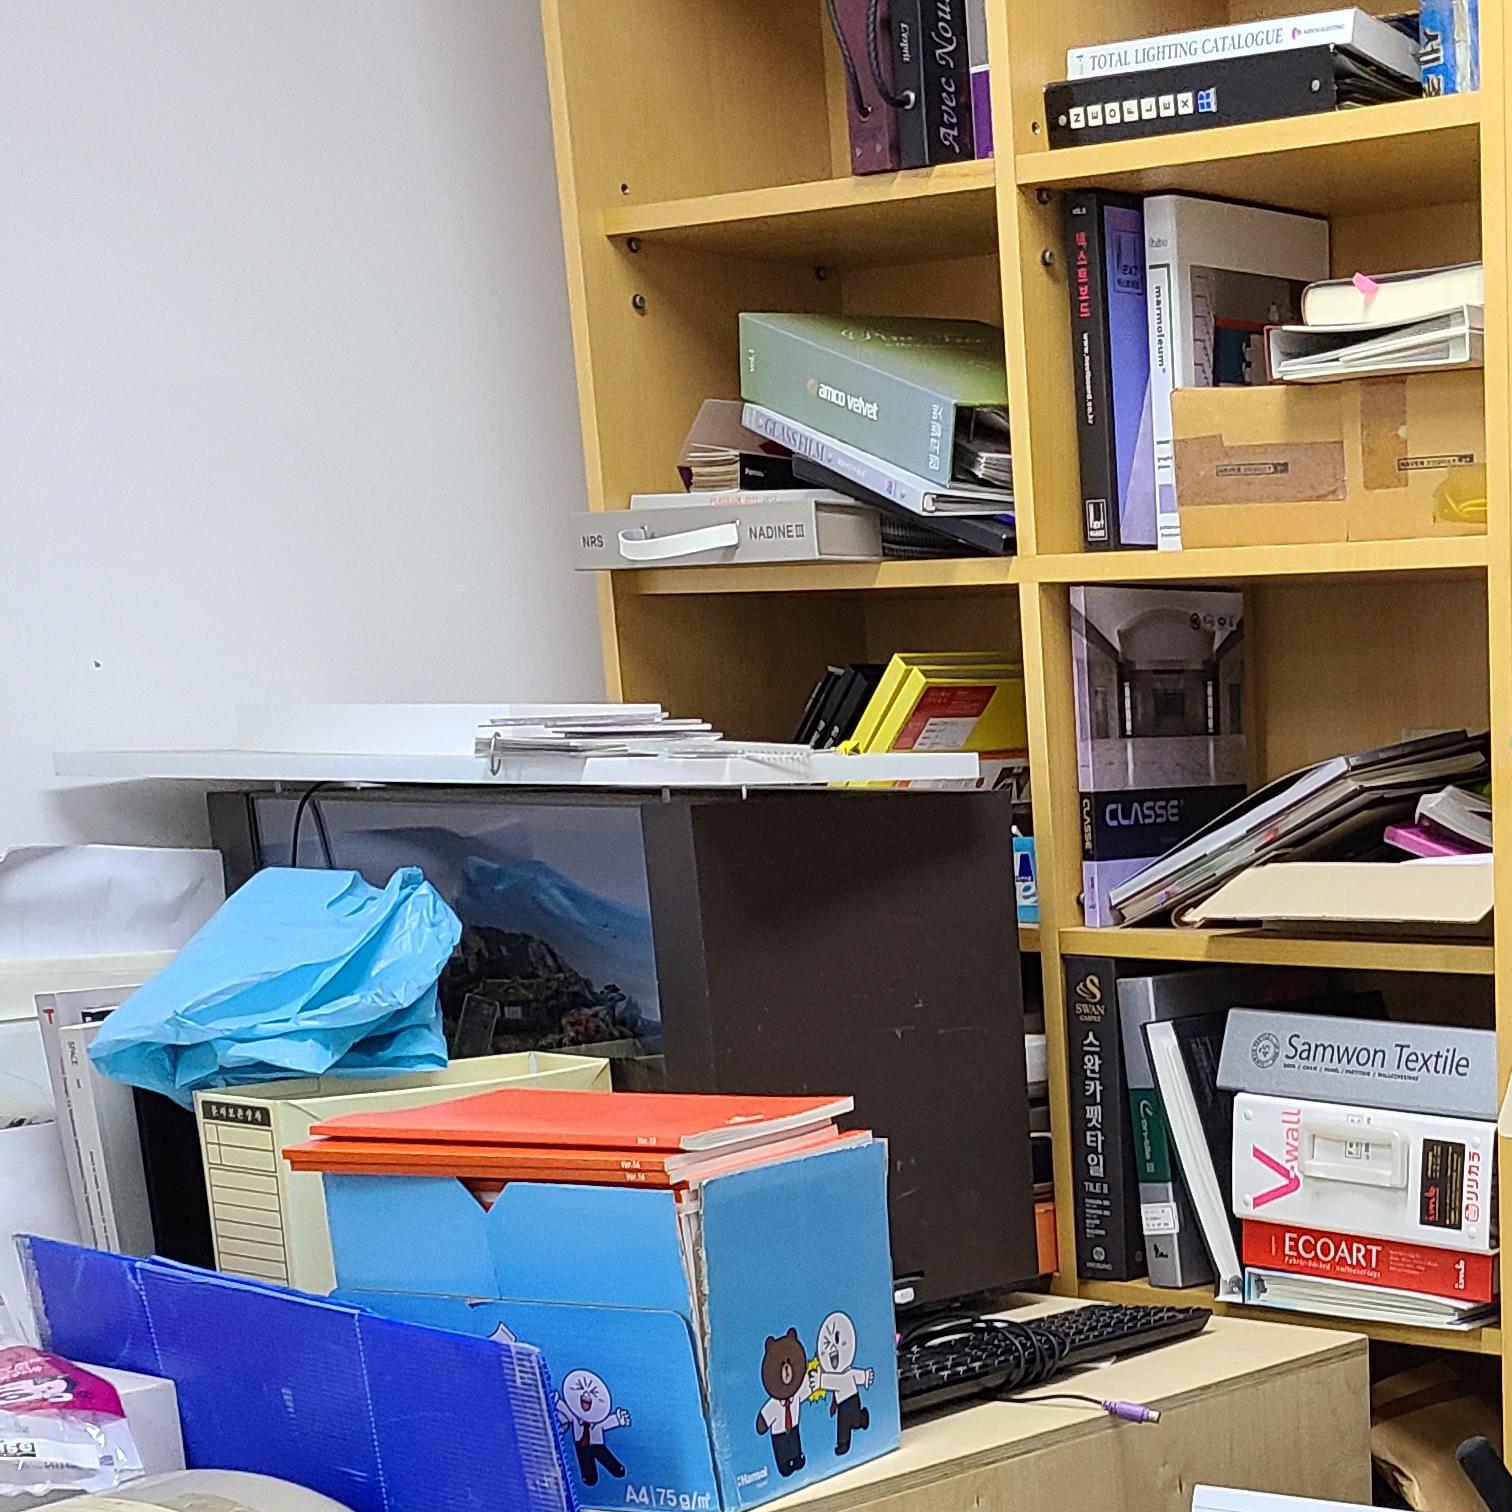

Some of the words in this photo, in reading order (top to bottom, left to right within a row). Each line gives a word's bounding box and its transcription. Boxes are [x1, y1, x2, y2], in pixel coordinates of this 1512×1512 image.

[1089, 52, 1131, 72] TOTAL
[1134, 41, 1198, 65] LIGHTING
[1201, 27, 1284, 55] CATALOGUE
[938, 77, 960, 153] Avec
[819, 384, 846, 408] amco
[847, 393, 879, 421] velvet
[763, 416, 798, 447] GLASS
[799, 437, 827, 463] FILM
[581, 535, 604, 549] NRS
[1083, 799, 1092, 850] CLASSE
[1105, 799, 1179, 827] CLASSE
[1075, 1003, 1104, 1015] SWAN
[67, 1040, 78, 1065] SPACE
[1284, 1033, 1386, 1069] Samwon
[1394, 1043, 1471, 1077] Textile
[1083, 1182, 1101, 1193] TILE
[1284, 1232, 1382, 1268] ECOART
